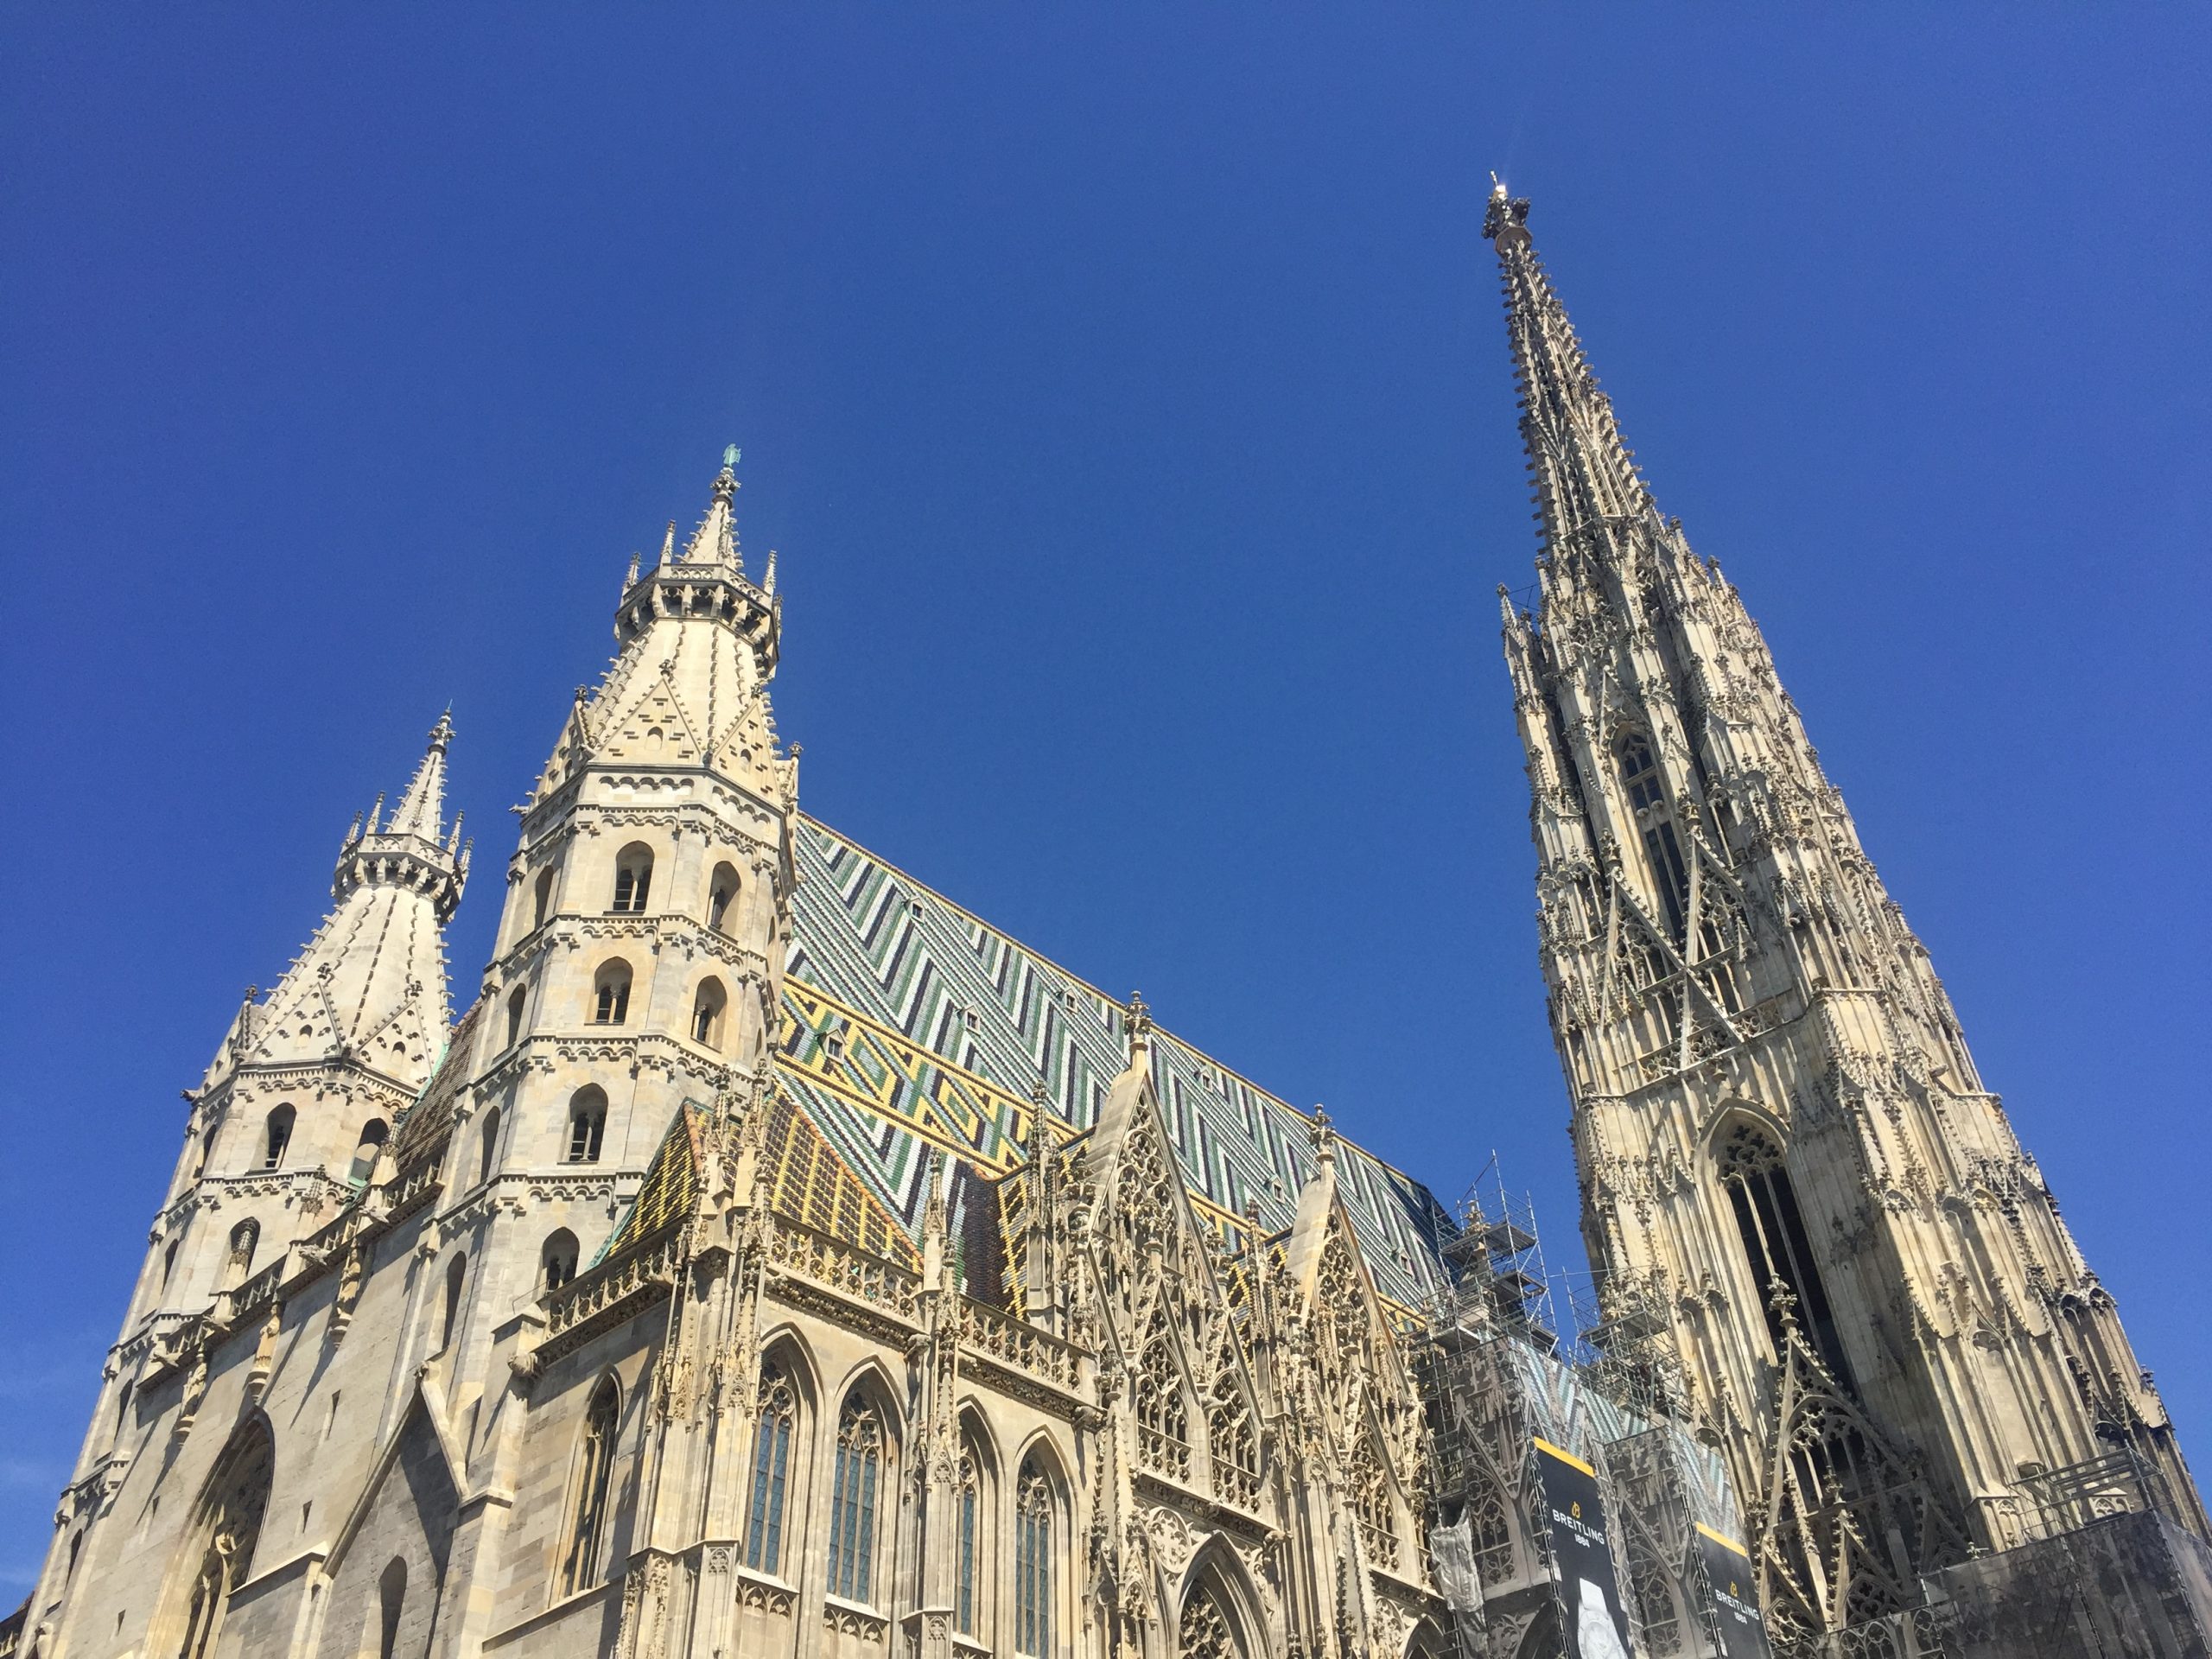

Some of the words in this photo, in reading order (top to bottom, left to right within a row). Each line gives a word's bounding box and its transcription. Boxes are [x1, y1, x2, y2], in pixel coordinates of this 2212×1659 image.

[1552, 1509, 1605, 1545] BREITLING
[1574, 1533, 1590, 1548] 1884
[1715, 1589, 1759, 1620] BREITLING
